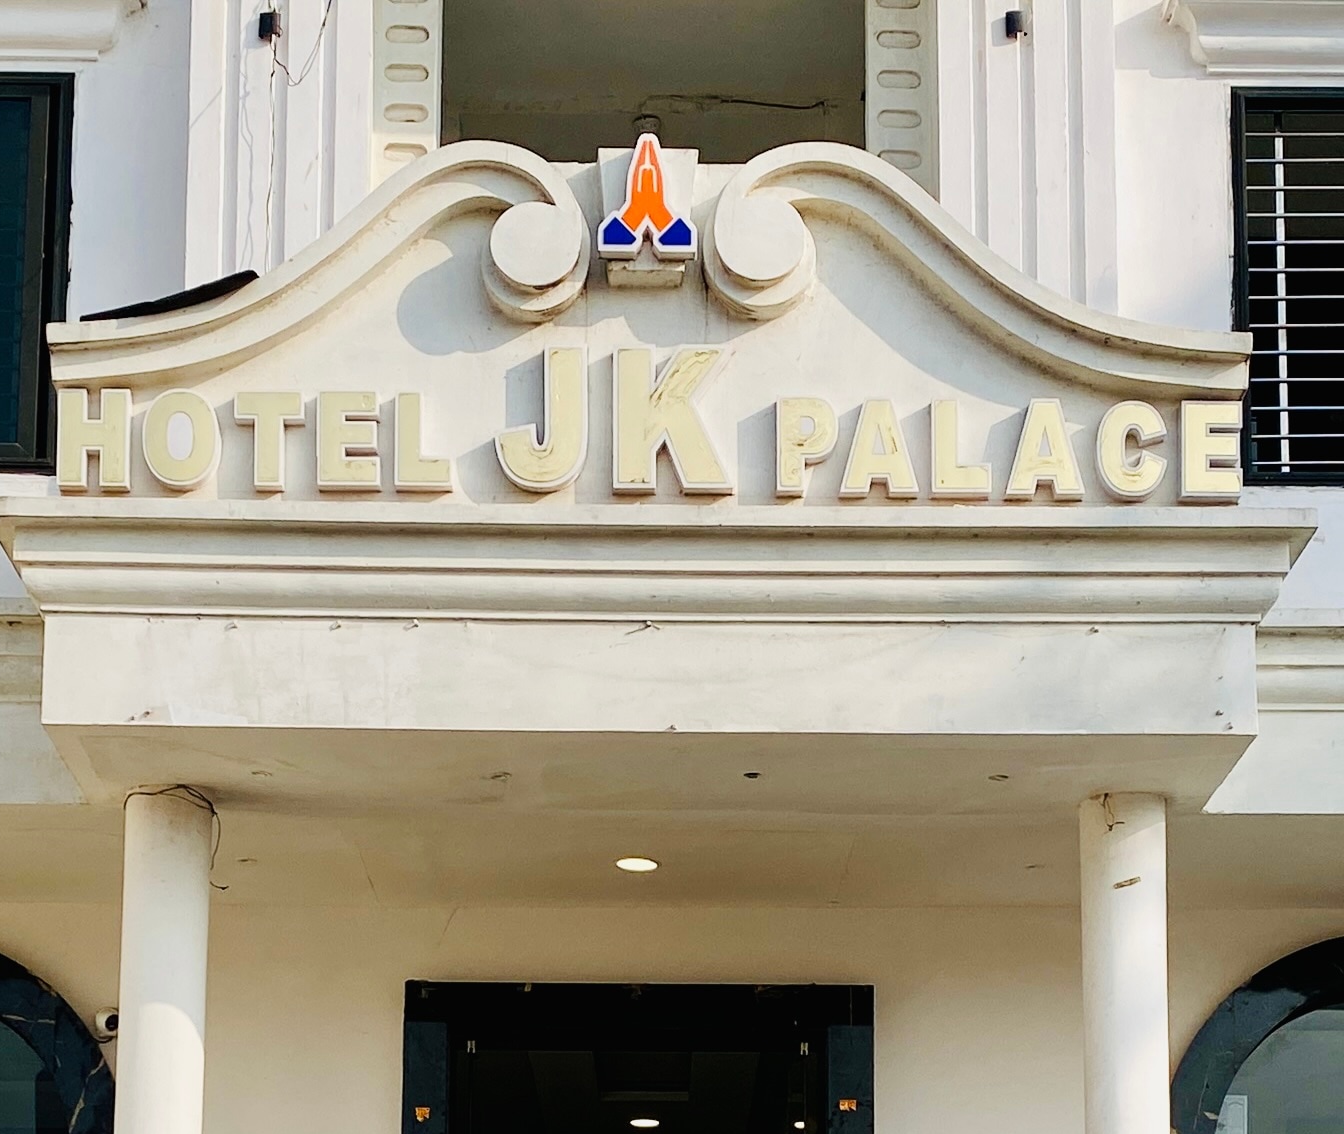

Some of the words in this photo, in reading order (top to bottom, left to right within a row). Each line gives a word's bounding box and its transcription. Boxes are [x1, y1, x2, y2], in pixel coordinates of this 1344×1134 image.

[58, 387, 452, 494] HOTEL
[494, 345, 736, 496] JK
[775, 399, 1244, 504] PALACE
